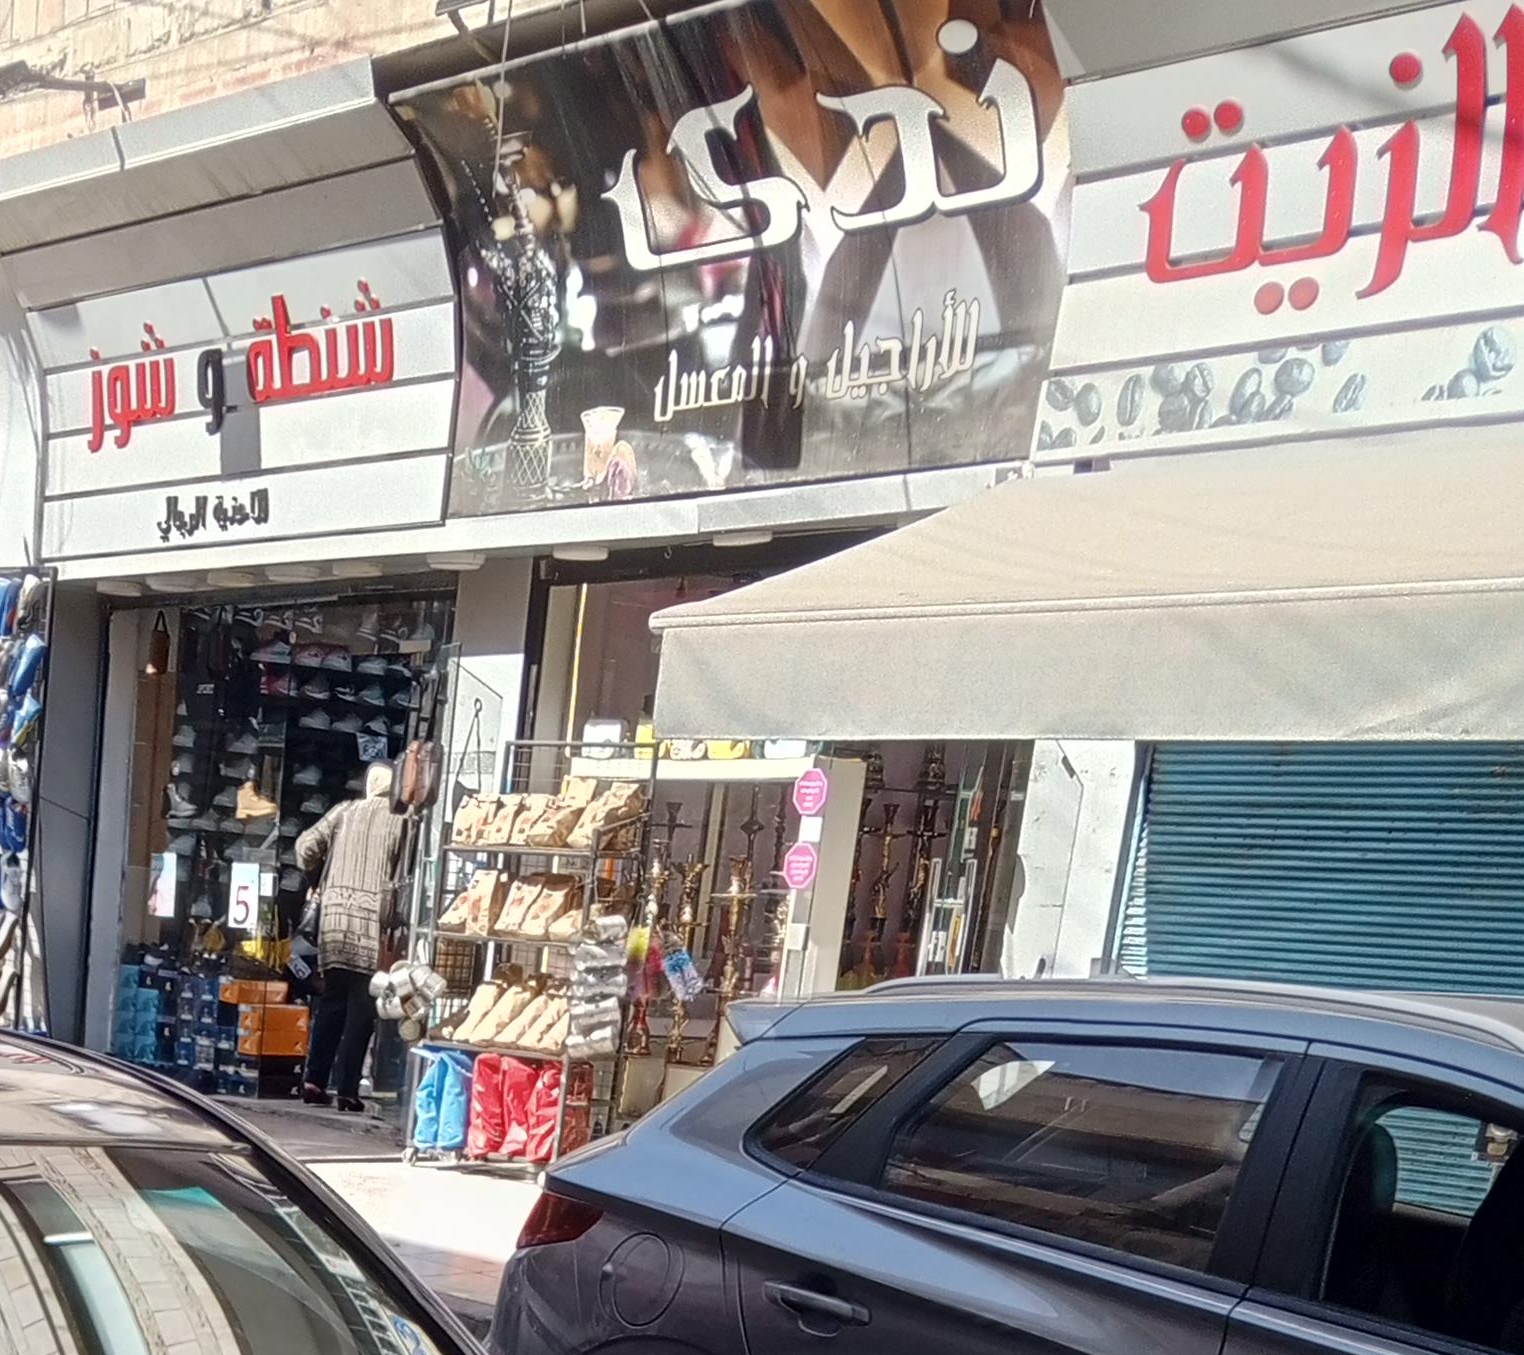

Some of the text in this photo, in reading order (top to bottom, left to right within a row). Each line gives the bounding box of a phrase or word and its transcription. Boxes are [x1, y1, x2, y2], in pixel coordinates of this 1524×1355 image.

[87, 321, 176, 453] شوز
[197, 347, 224, 437] و
[654, 334, 774, 423] المعسل
[790, 353, 809, 410] و
[233, 885, 250, 925] 5
